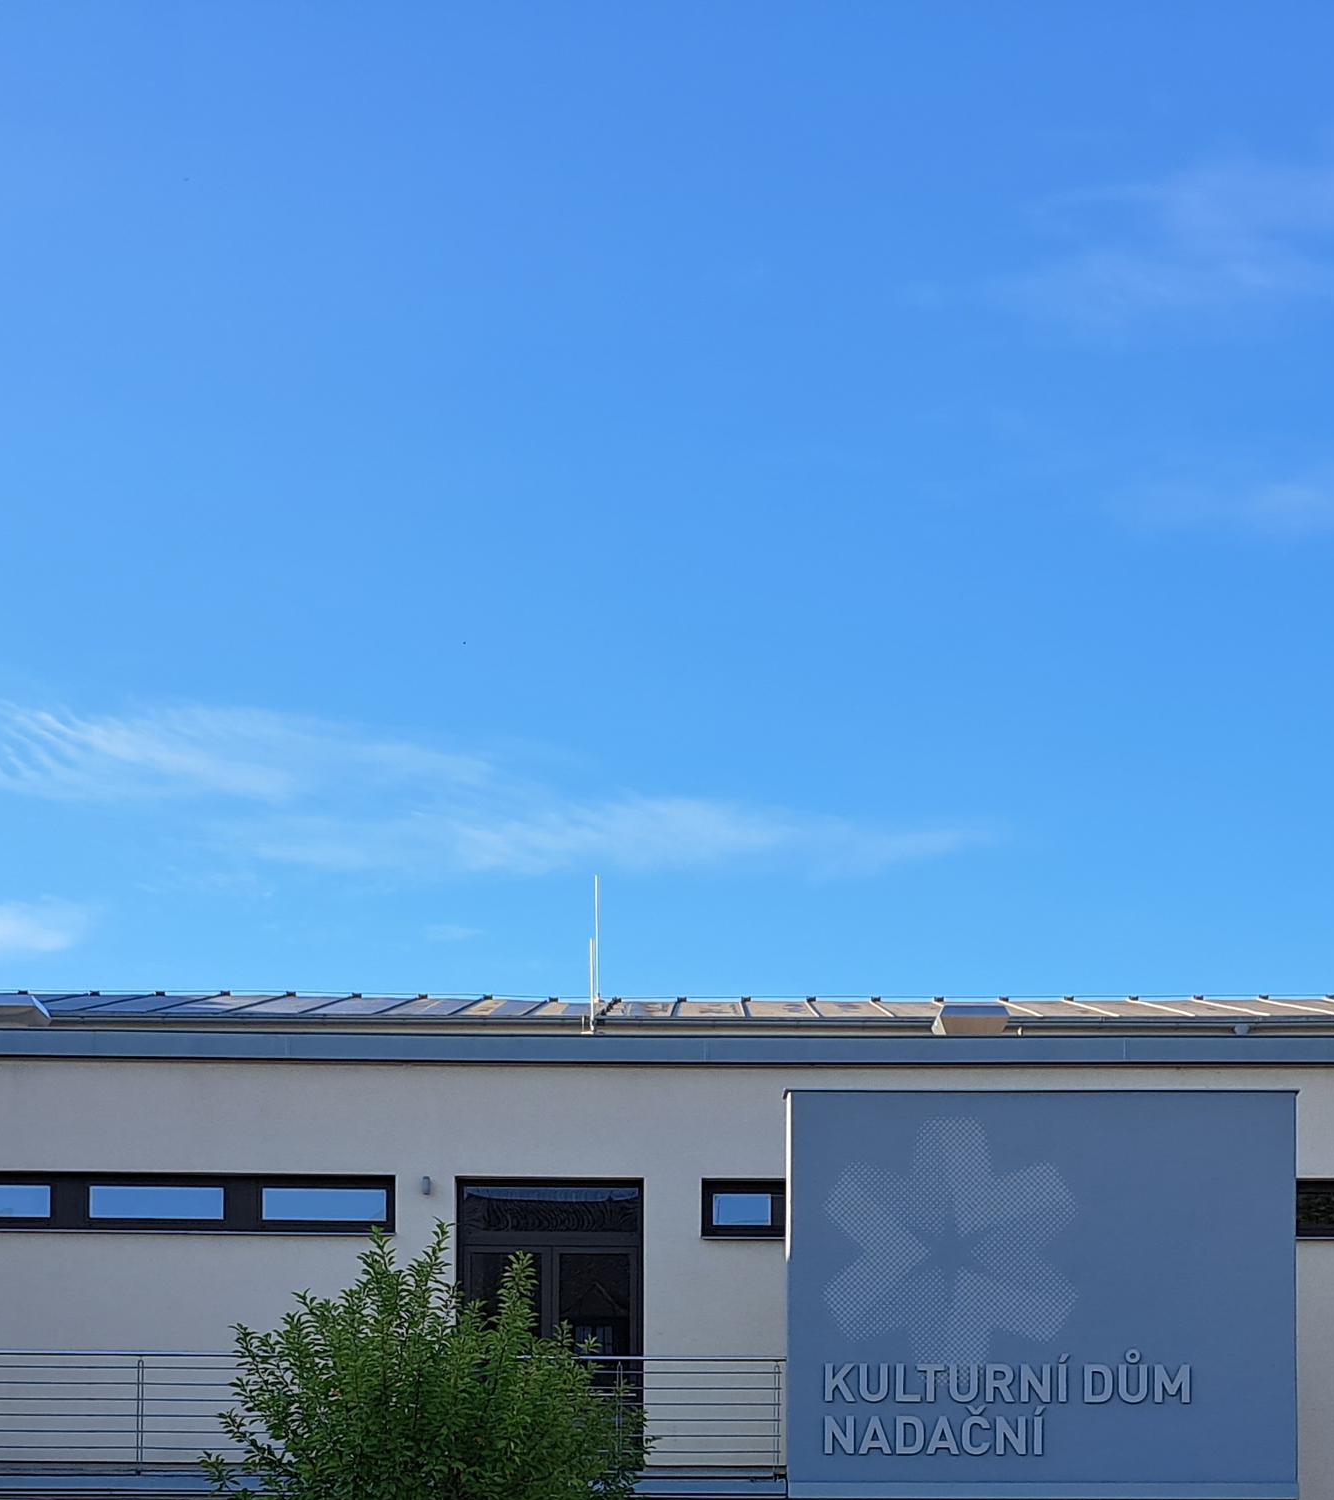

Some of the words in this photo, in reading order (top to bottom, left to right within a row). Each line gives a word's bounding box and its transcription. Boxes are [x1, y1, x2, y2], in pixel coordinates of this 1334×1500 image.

[822, 1354, 1069, 1403] KULTURNÍ
[1082, 1348, 1192, 1404] DŮM
[822, 1406, 1045, 1456] NADAČNÍ
